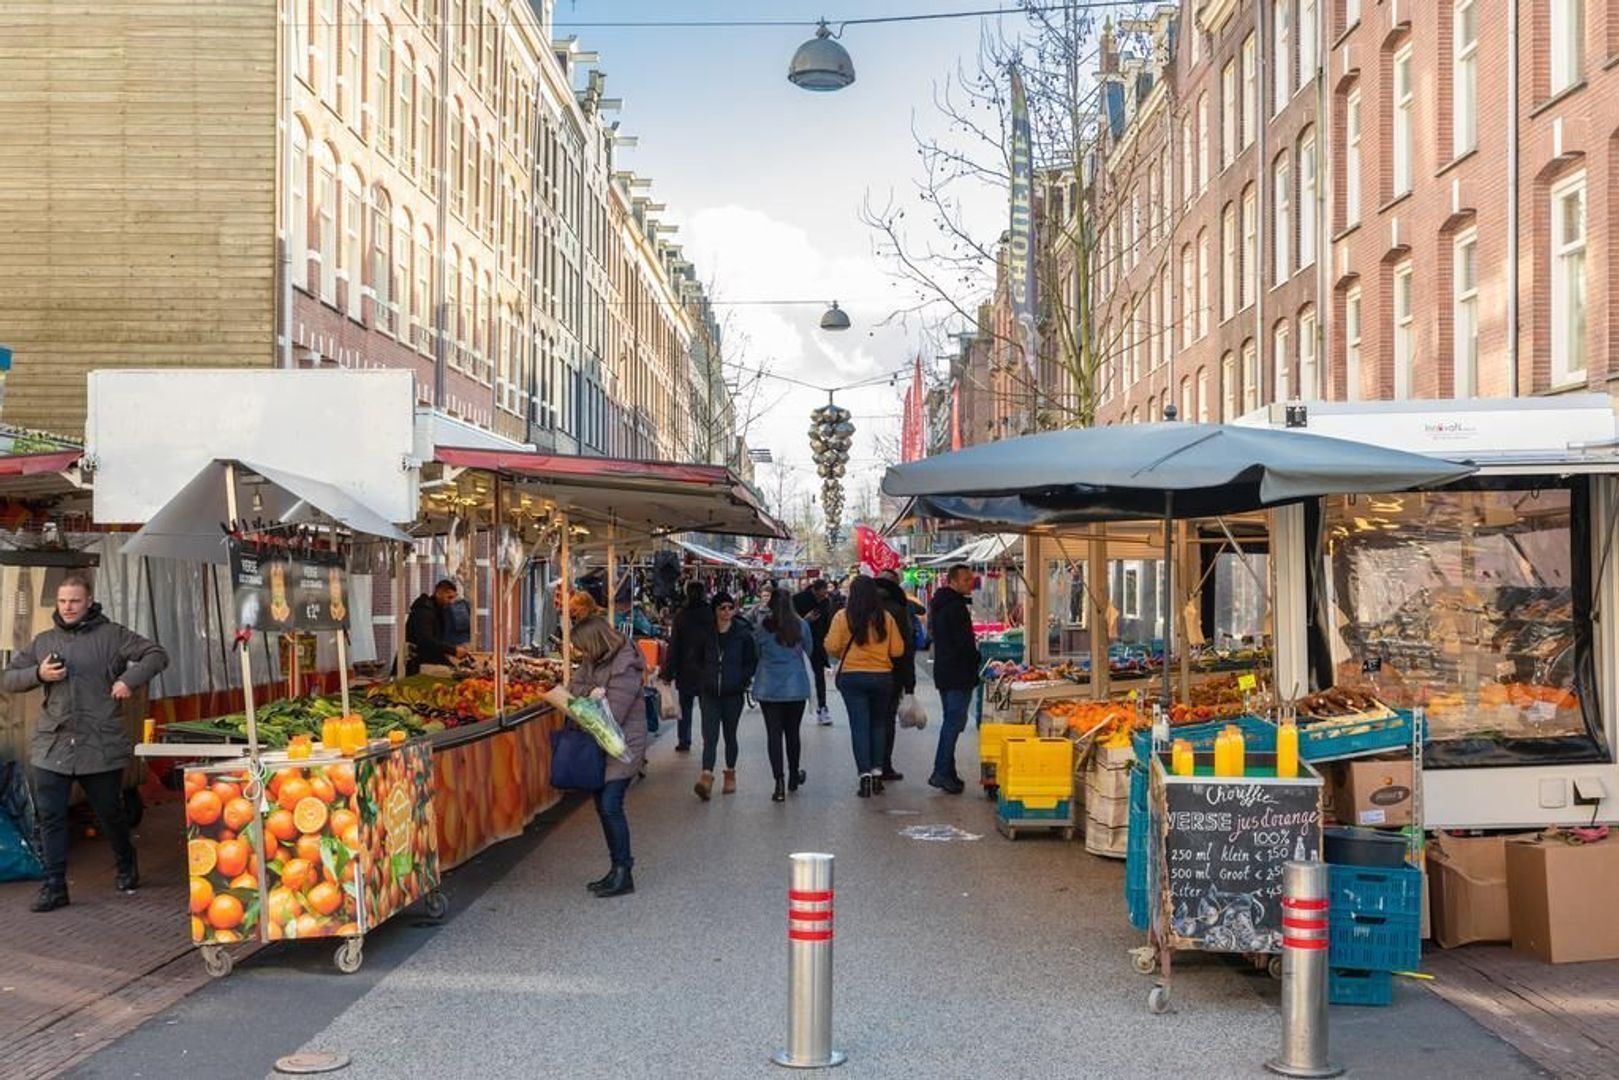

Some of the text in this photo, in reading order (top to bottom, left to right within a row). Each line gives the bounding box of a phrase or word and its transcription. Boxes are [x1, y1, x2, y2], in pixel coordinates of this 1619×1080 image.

[1206, 784, 1279, 807] Chouffie
[1229, 815, 1259, 842] jus
[1253, 829, 1290, 846] 100%
[1171, 848, 1192, 861] 250
[1195, 842, 1212, 861] ml
[1220, 845, 1249, 861] klein
[1171, 868, 1192, 879] 500
[1195, 862, 1211, 879] ml
[1219, 865, 1251, 880] Groot
[1170, 882, 1202, 897] Liter
